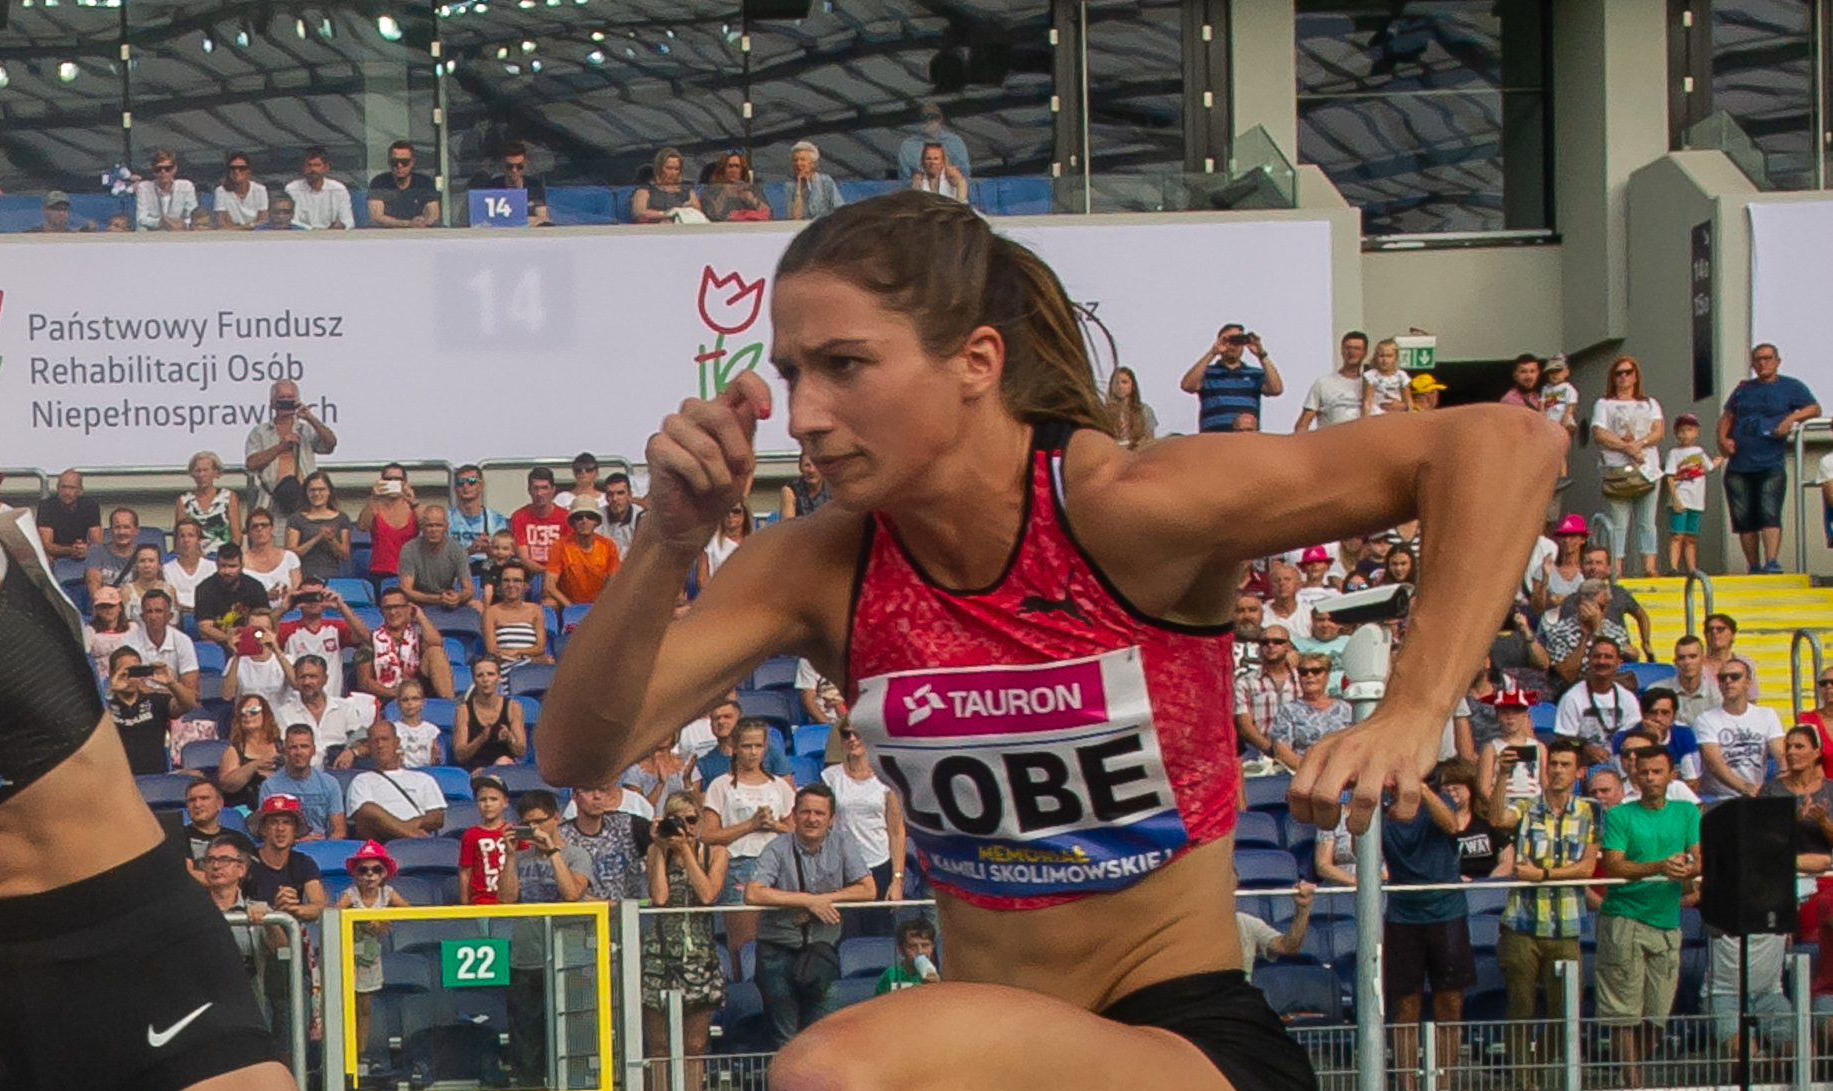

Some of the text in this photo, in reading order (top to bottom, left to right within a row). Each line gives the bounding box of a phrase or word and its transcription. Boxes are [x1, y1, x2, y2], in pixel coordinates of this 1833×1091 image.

[484, 197, 512, 218] 14
[468, 267, 546, 336] 14
[28, 309, 344, 348] Państwowy Fundusz
[30, 352, 304, 391] Rehabilitacji Osób
[947, 683, 1082, 718] TAURON
[878, 733, 1162, 835] LOBE
[456, 945, 496, 980] 22
